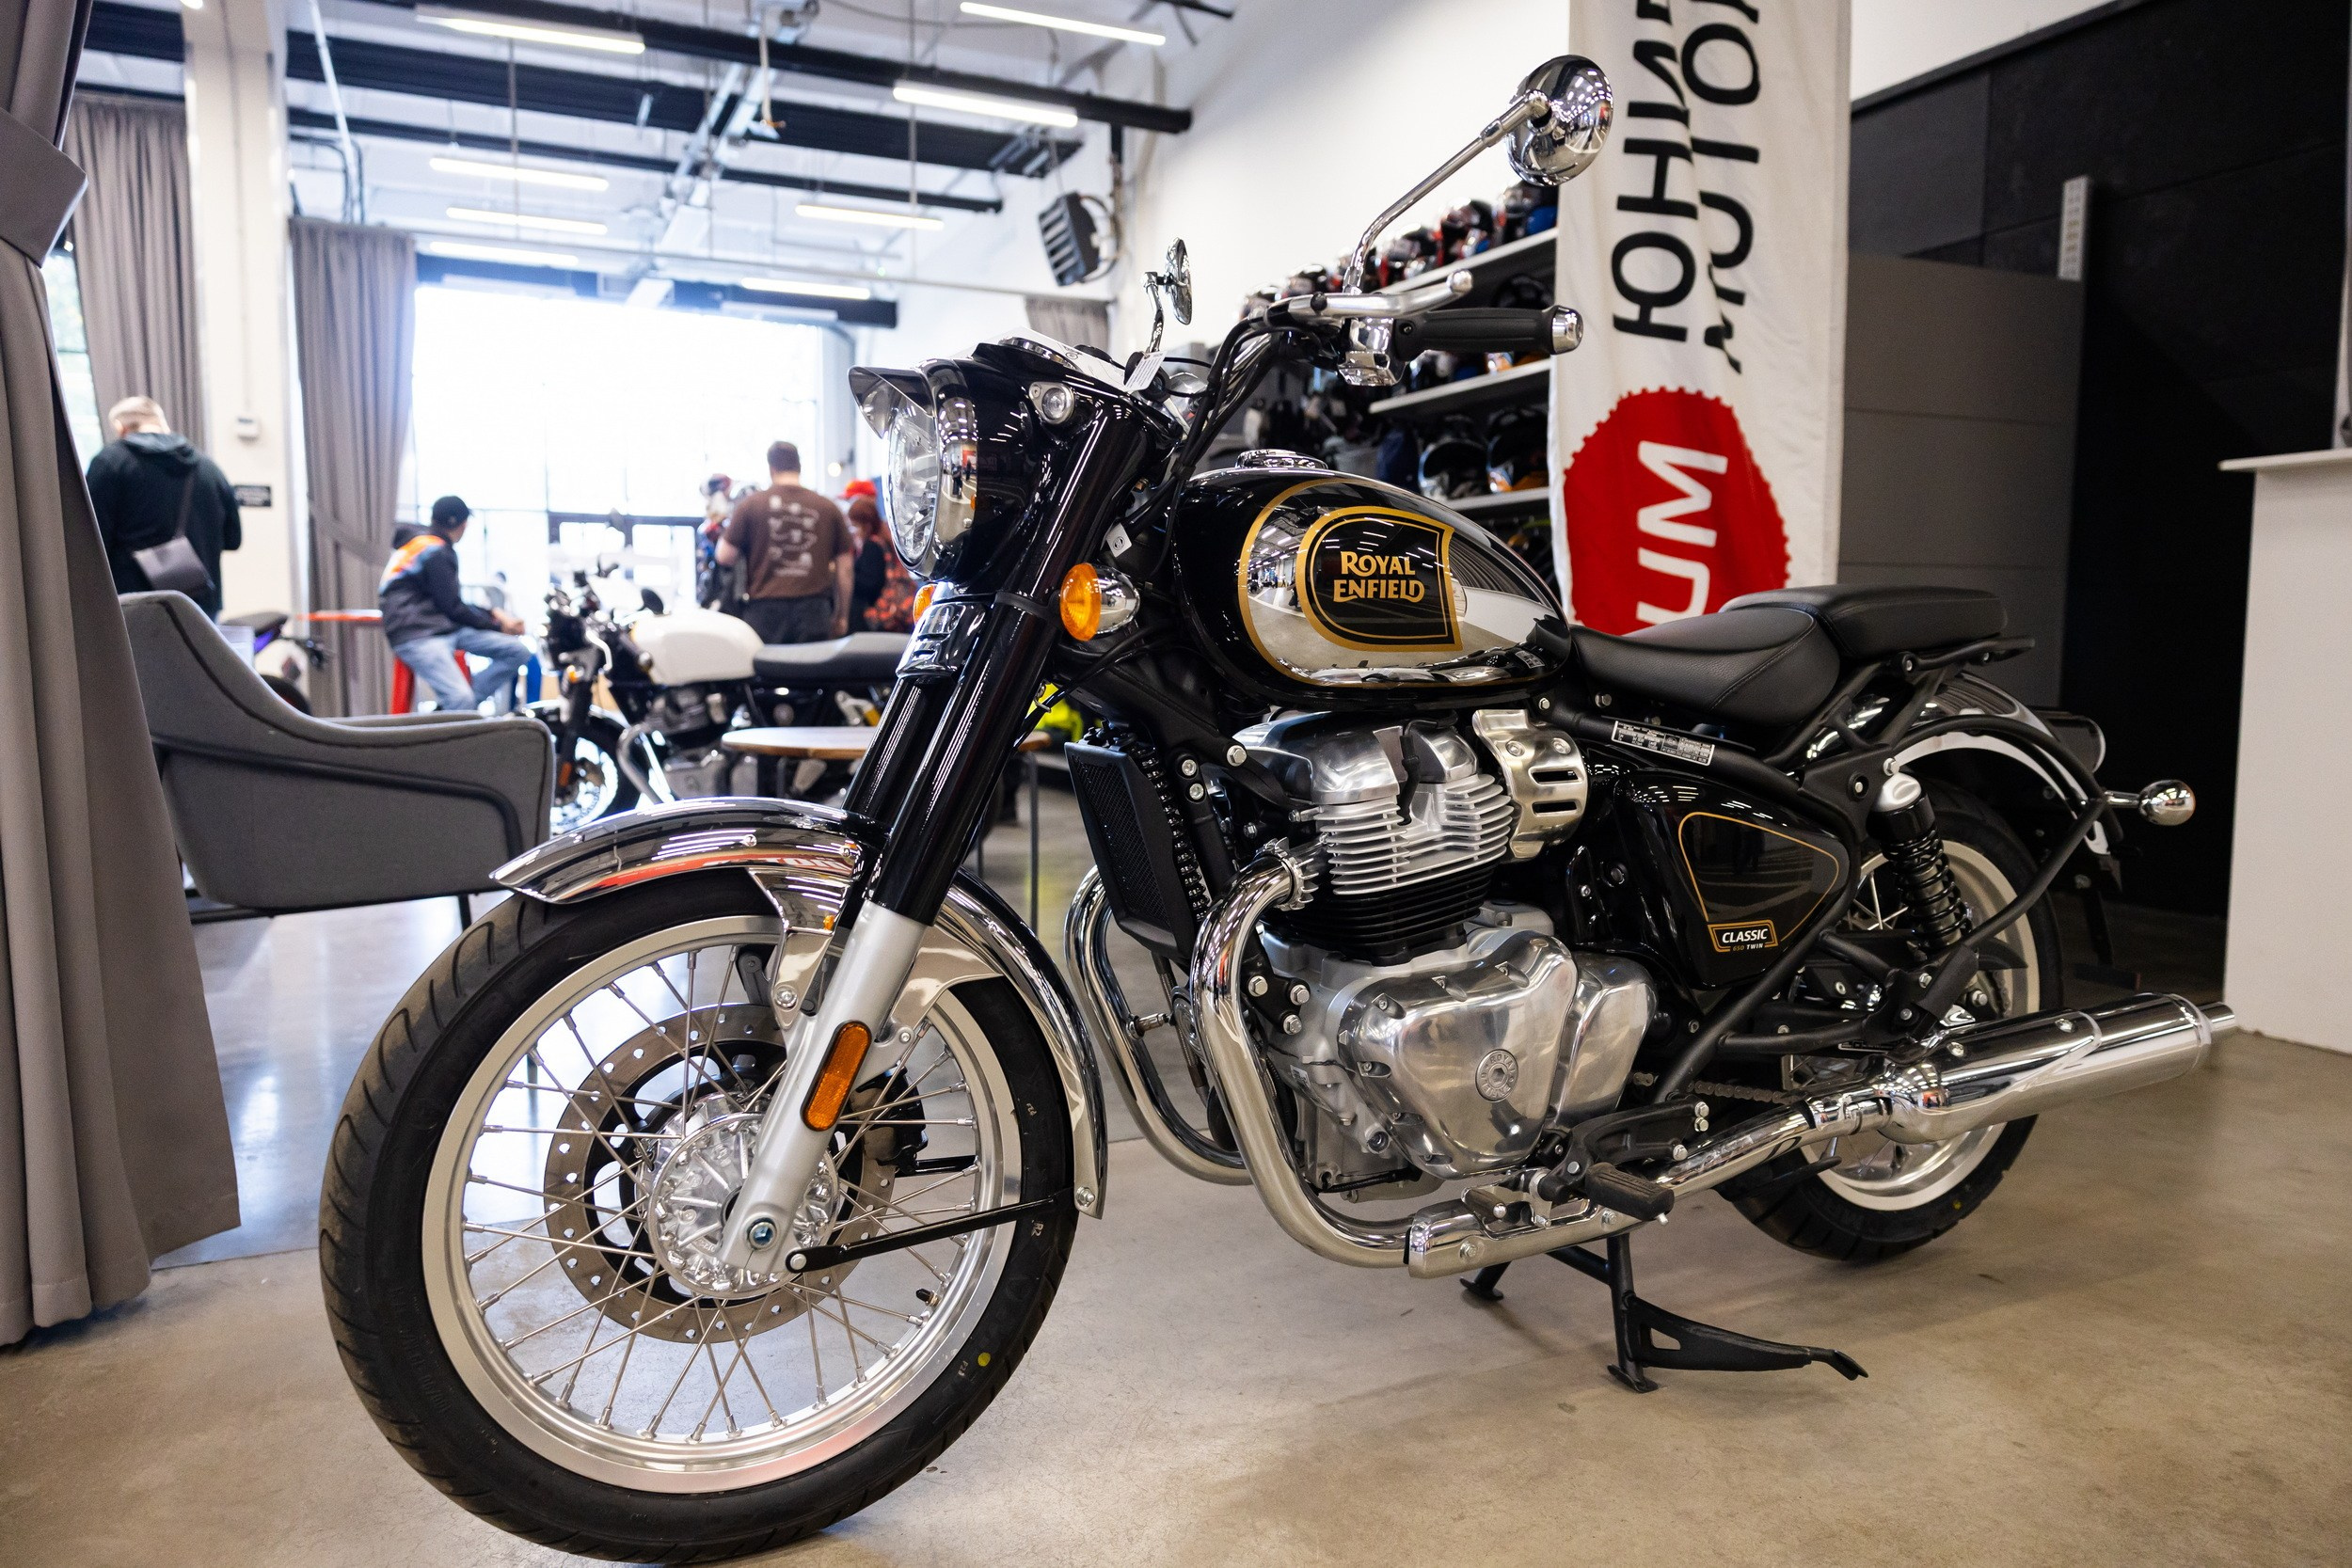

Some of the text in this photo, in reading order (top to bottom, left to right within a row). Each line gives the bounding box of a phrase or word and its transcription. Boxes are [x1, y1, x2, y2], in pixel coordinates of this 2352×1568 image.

[1612, 0, 1698, 342] ЮНИ
[1340, 550, 1415, 578] ROYAL
[1333, 578, 1425, 603] ENFIELD
[1722, 928, 1769, 943] CLASSIC
